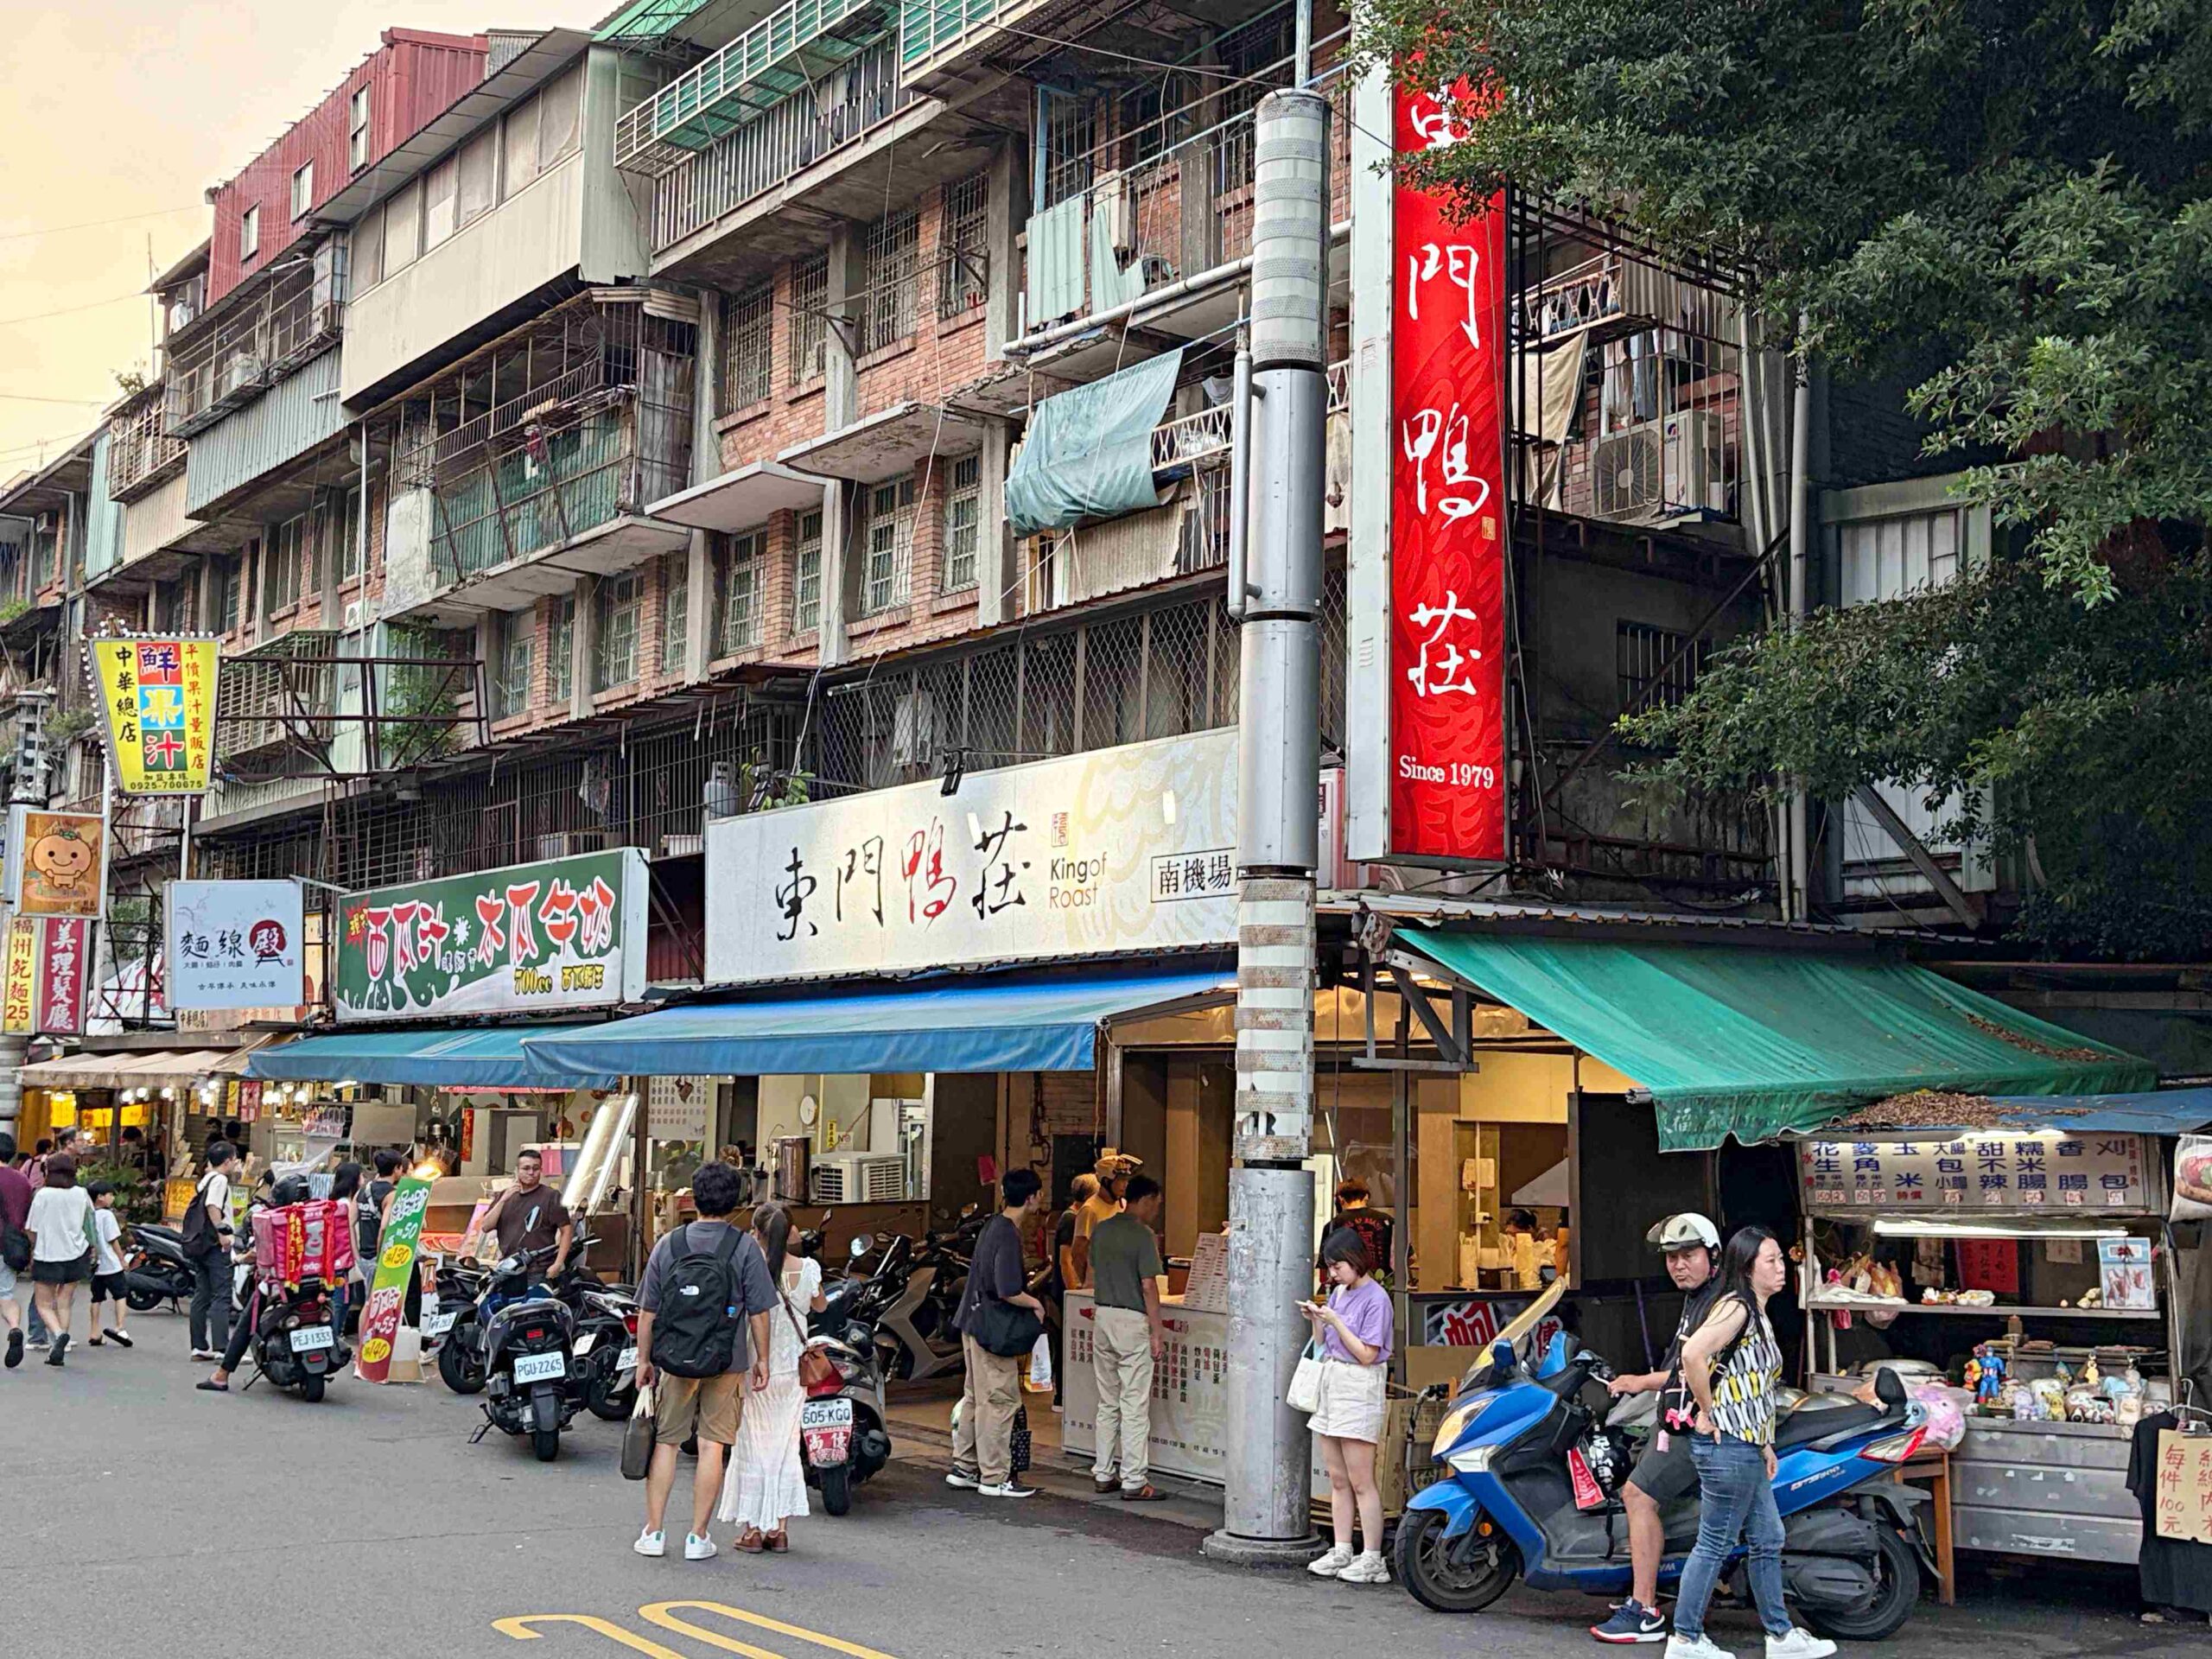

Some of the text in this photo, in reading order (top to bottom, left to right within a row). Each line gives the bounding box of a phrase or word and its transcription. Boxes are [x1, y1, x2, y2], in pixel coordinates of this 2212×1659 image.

[115, 646, 138, 743] 中華總店
[140, 646, 185, 769] 鮮果汁
[185, 644, 207, 771] 平價果汁量販店
[130, 780, 203, 790] 0925-700675
[1399, 754, 1494, 789] Since 1979
[776, 810, 1032, 943] 東門鴨莊
[1049, 882, 1098, 909] Roast
[1158, 855, 1240, 895] 南機場
[180, 927, 282, 960] 麵線殿
[367, 875, 616, 982] 西瓜汁 木瓜牛奶
[10, 918, 35, 1002] 福州乾麵
[45, 918, 78, 1031] 美理髮廳
[514, 967, 552, 995] 700cc
[1813, 1141, 1842, 1173] 花生
[1891, 1141, 1923, 1188] 玉米
[1976, 1141, 2009, 1191] 甜不辣
[2014, 1141, 2048, 1190] 糯米腸
[2055, 1140, 2088, 1191] 香腸
[2096, 1139, 2130, 1190] 刈包
[379, 1316, 397, 1335] 55
[518, 1358, 563, 1377] PGU-2265
